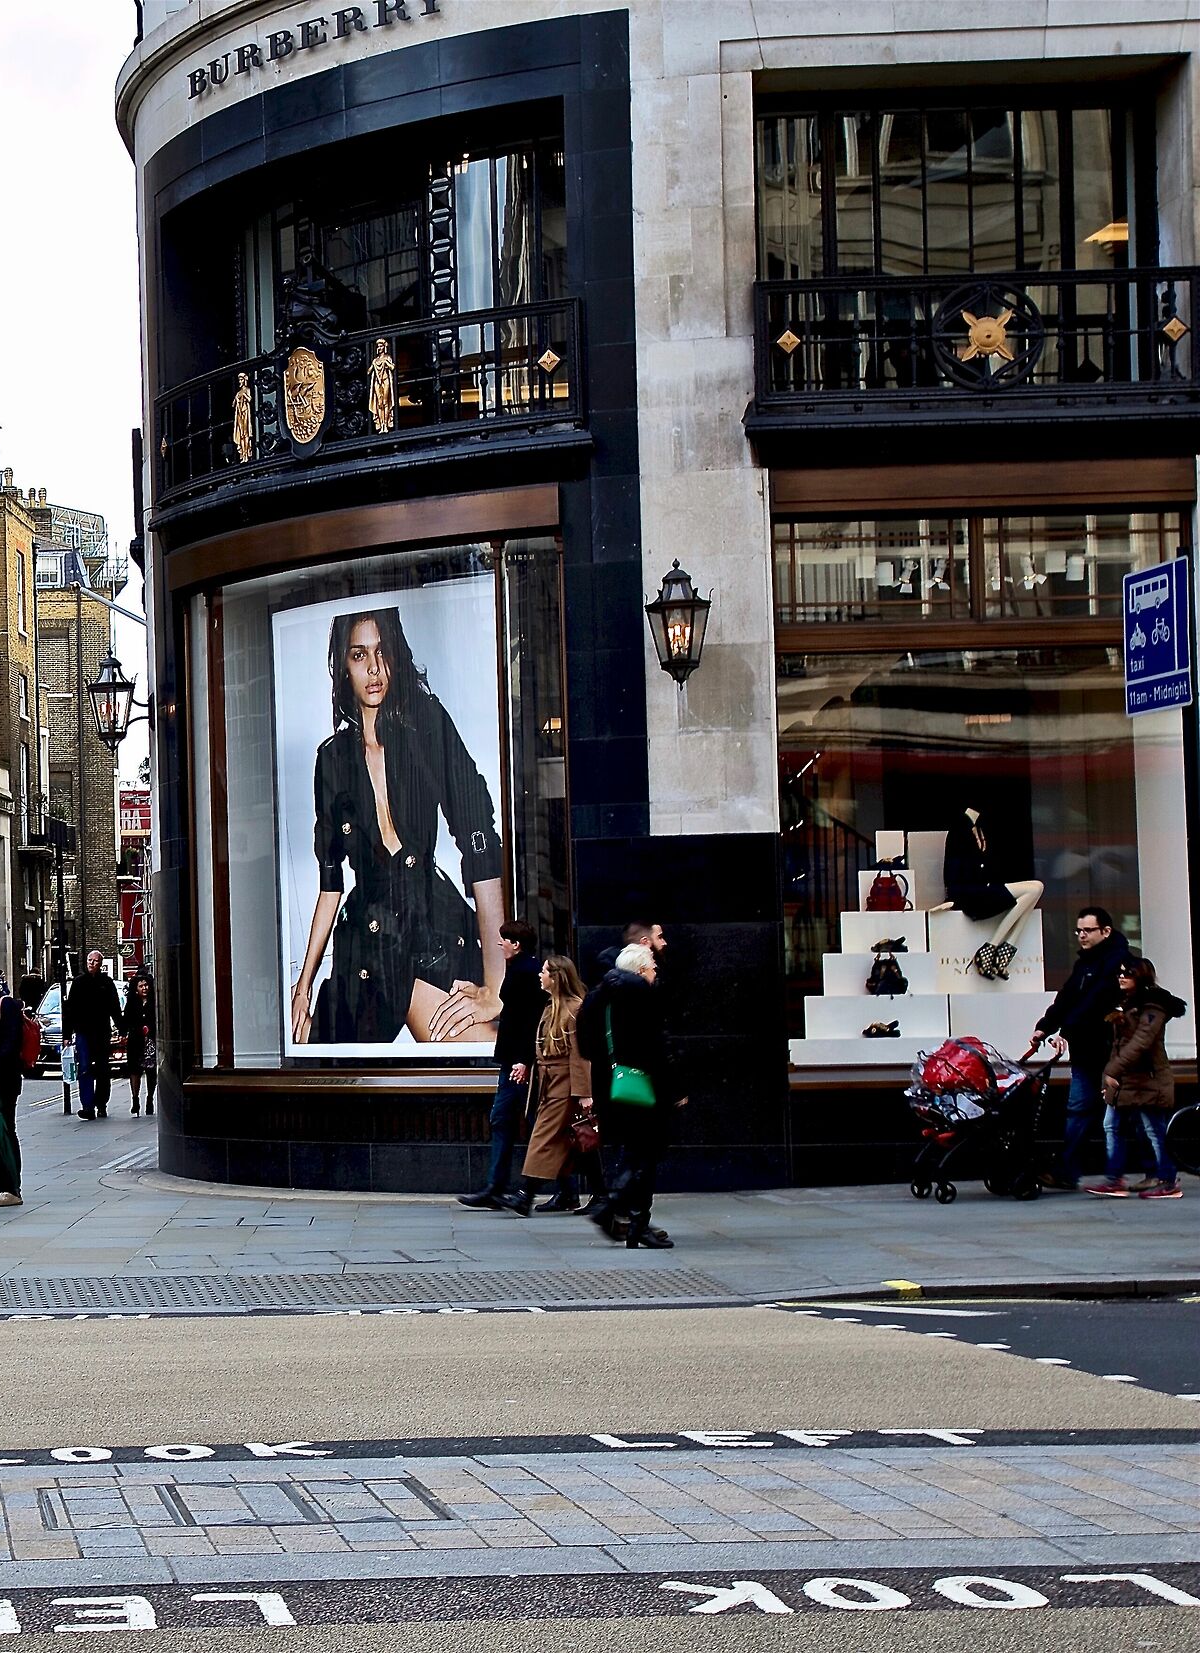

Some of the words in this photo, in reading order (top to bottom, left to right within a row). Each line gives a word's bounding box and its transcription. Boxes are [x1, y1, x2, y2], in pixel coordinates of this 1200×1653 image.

[1130, 655, 1145, 673] taxi
[1129, 691, 1148, 706] 11am
[1153, 680, 1188, 701] Midnight
[590, 1429, 985, 1448] LEFT
[658, 1573, 1200, 1615] LOOK
